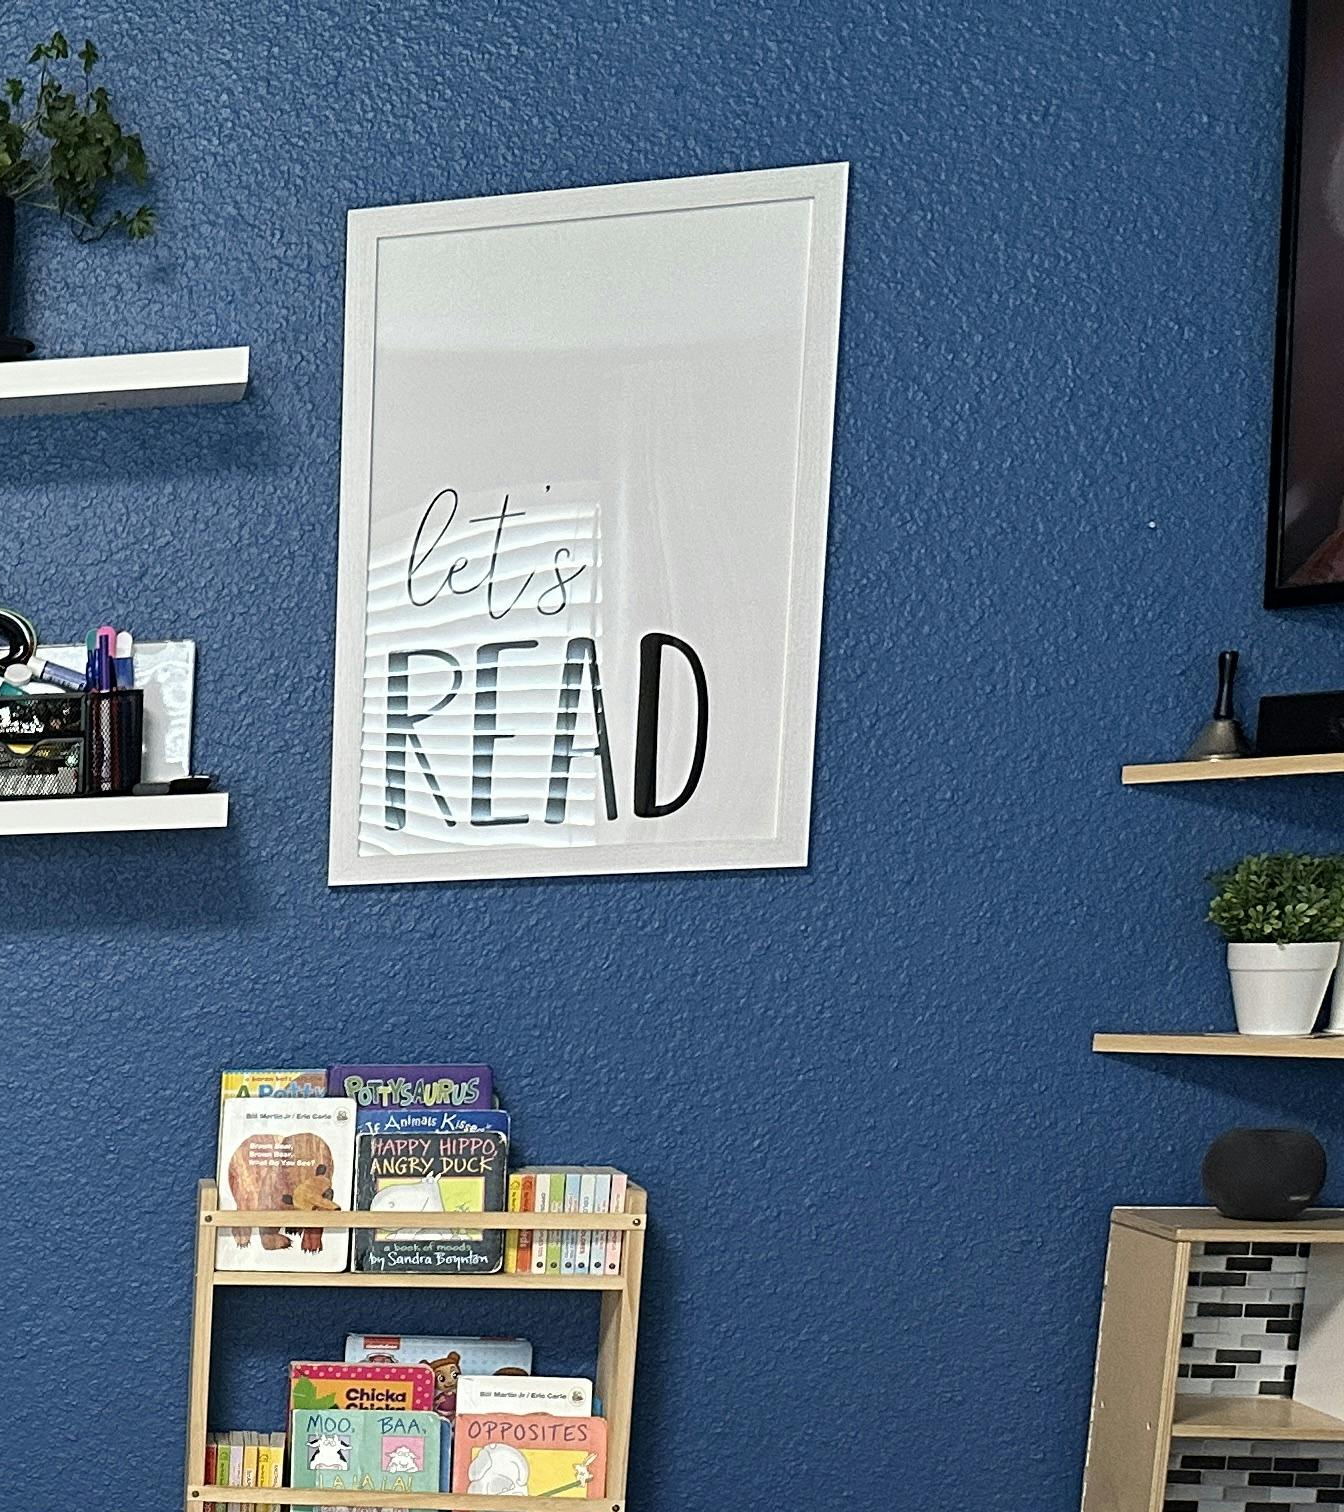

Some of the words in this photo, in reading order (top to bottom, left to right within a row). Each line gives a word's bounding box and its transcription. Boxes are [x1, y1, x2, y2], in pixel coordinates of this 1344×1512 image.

[408, 484, 586, 620] let's
[384, 633, 709, 831] READ
[344, 1075, 480, 1108] POTTYSAURUS
[384, 1115, 437, 1131] Animals
[370, 1137, 431, 1157] HAPPY
[439, 1137, 499, 1157] HIPPO,
[370, 1156, 434, 1175] ANGRY
[439, 1156, 493, 1174] DUCK
[369, 1252, 385, 1270] by
[388, 1251, 432, 1266] Sandra
[434, 1251, 489, 1271] Boynton
[345, 1388, 407, 1403] Chicka
[377, 1416, 427, 1434] BAA,
[468, 1420, 588, 1442] OPPOSITES
